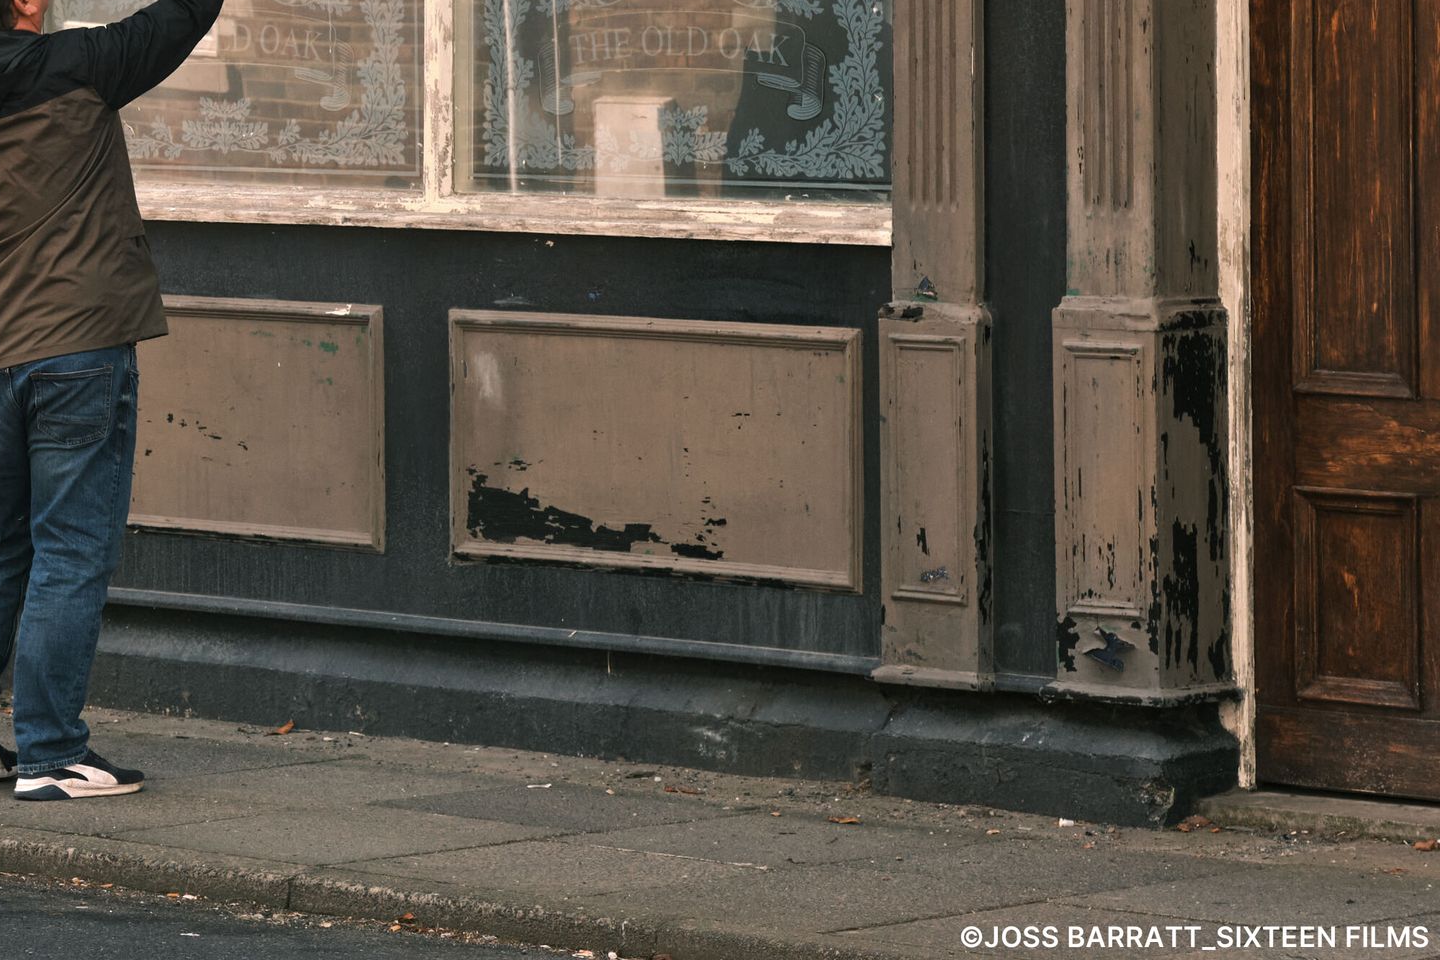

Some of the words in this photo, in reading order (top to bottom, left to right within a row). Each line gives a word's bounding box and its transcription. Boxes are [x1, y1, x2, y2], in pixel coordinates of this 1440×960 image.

[260, 24, 323, 62] OAK
[568, 27, 634, 65] THE
[641, 25, 709, 58] OLD
[718, 27, 791, 68] OAK
